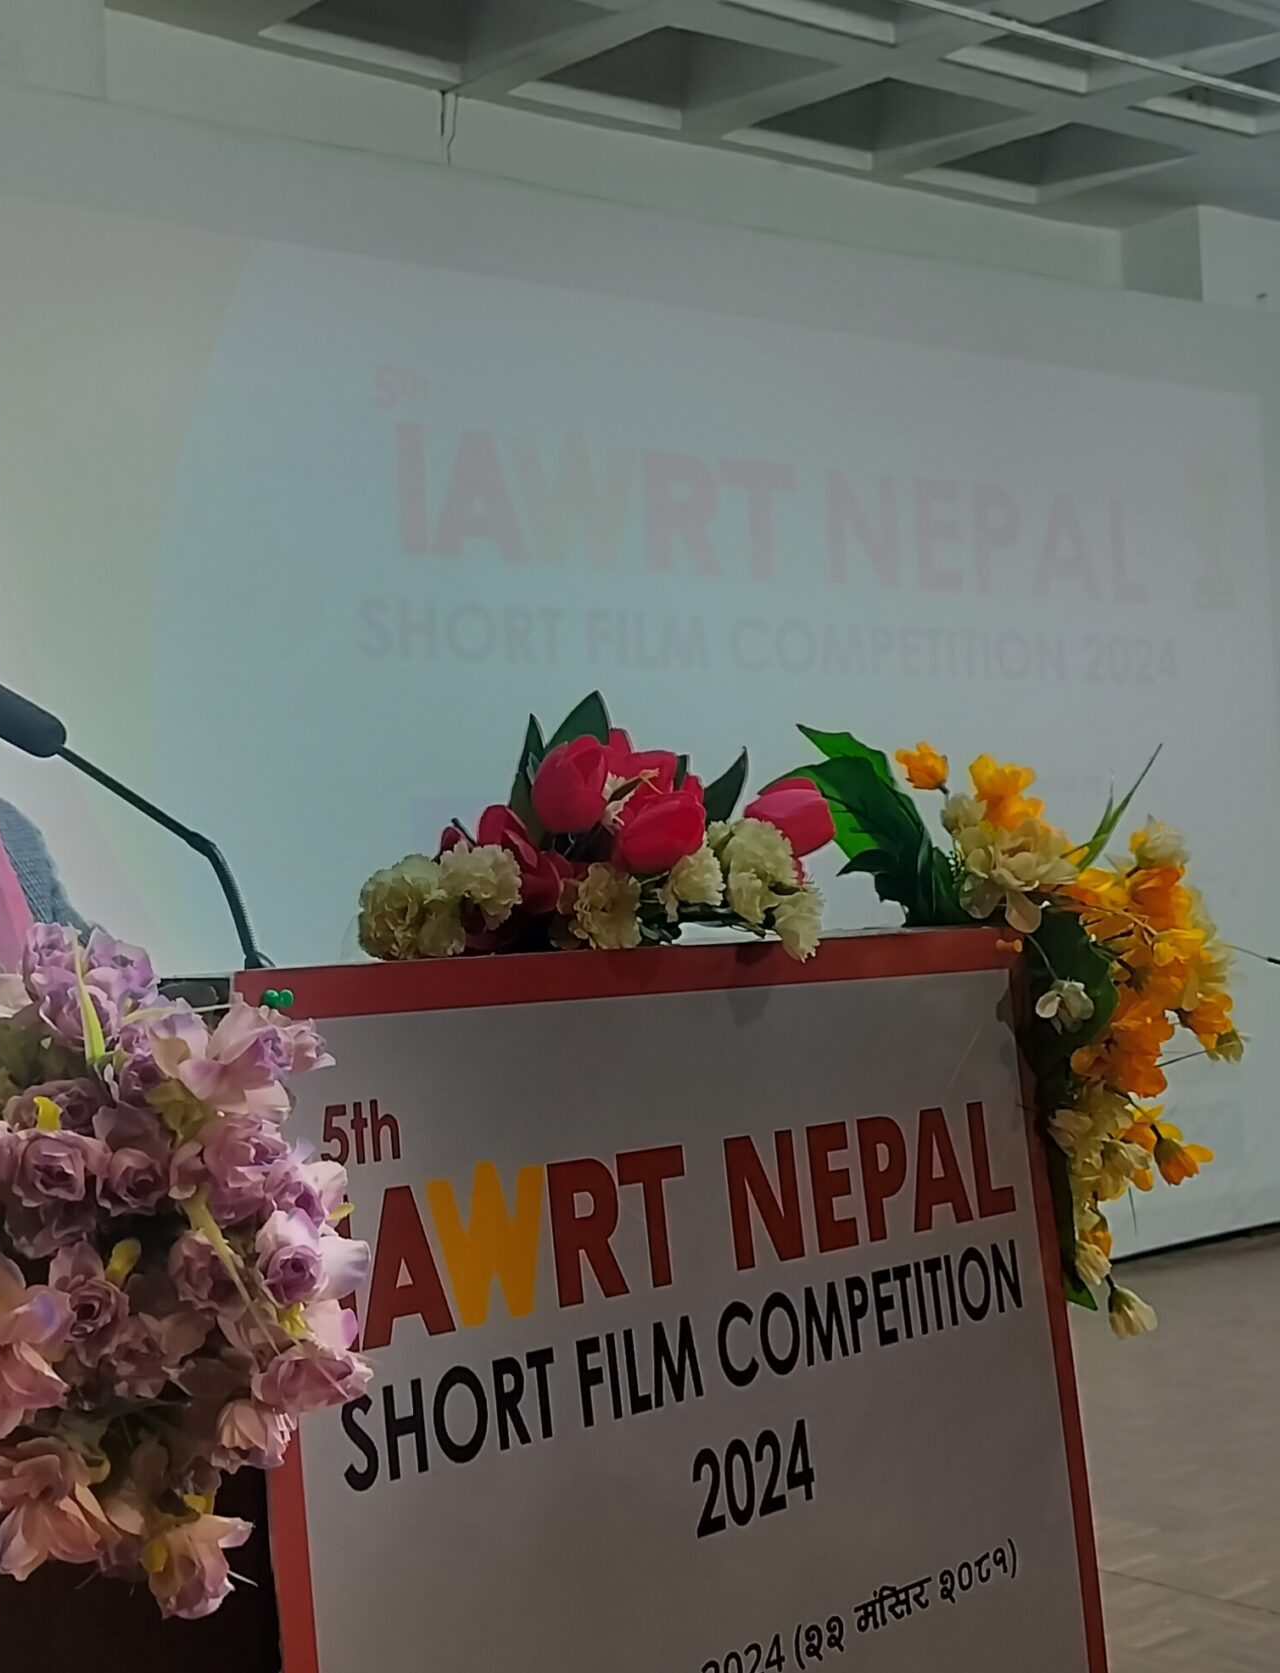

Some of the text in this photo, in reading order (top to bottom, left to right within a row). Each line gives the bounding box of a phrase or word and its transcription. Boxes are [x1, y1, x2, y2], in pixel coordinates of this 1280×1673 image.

[394, 421, 1150, 604] IAWRT NEPAL
[357, 598, 1179, 687] SHORT FILM COMPETITION 2024
[321, 1098, 401, 1165] 5th
[332, 1101, 1017, 1353] AWRT NEPAL
[341, 1239, 1024, 1491] SHORT FILM COMPETITION
[692, 1418, 816, 1538] 2024
[853, 1576, 932, 1634] मंसिर
